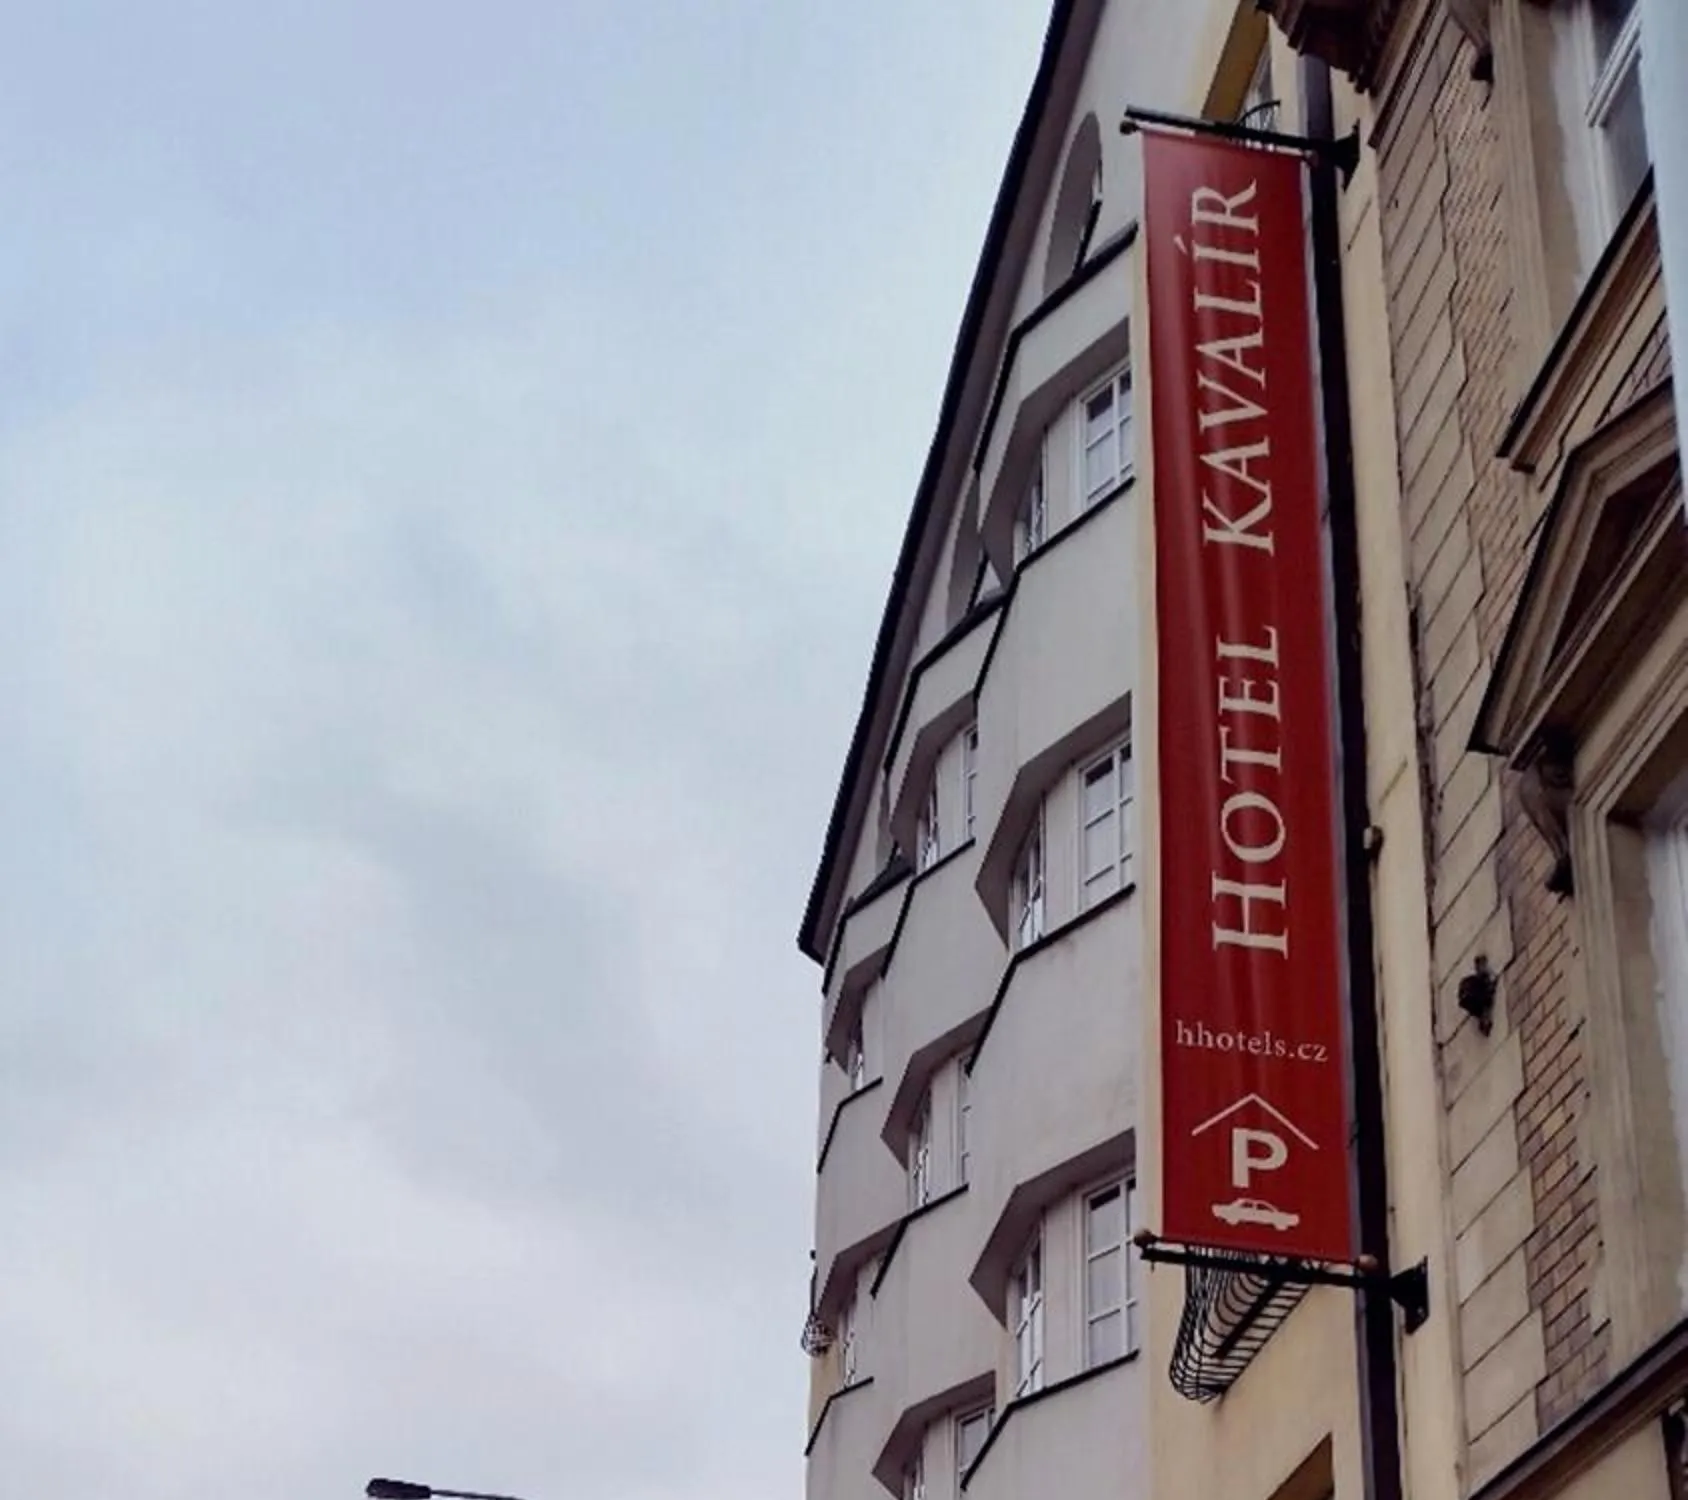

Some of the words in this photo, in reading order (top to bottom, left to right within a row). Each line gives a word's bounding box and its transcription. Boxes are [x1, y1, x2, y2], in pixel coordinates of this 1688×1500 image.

[1173, 178, 1274, 557] KAVALÍR
[1211, 625, 1289, 960] HOTEL
[1176, 1019, 1329, 1063] hhotels.cz
[1231, 1127, 1289, 1189] P
